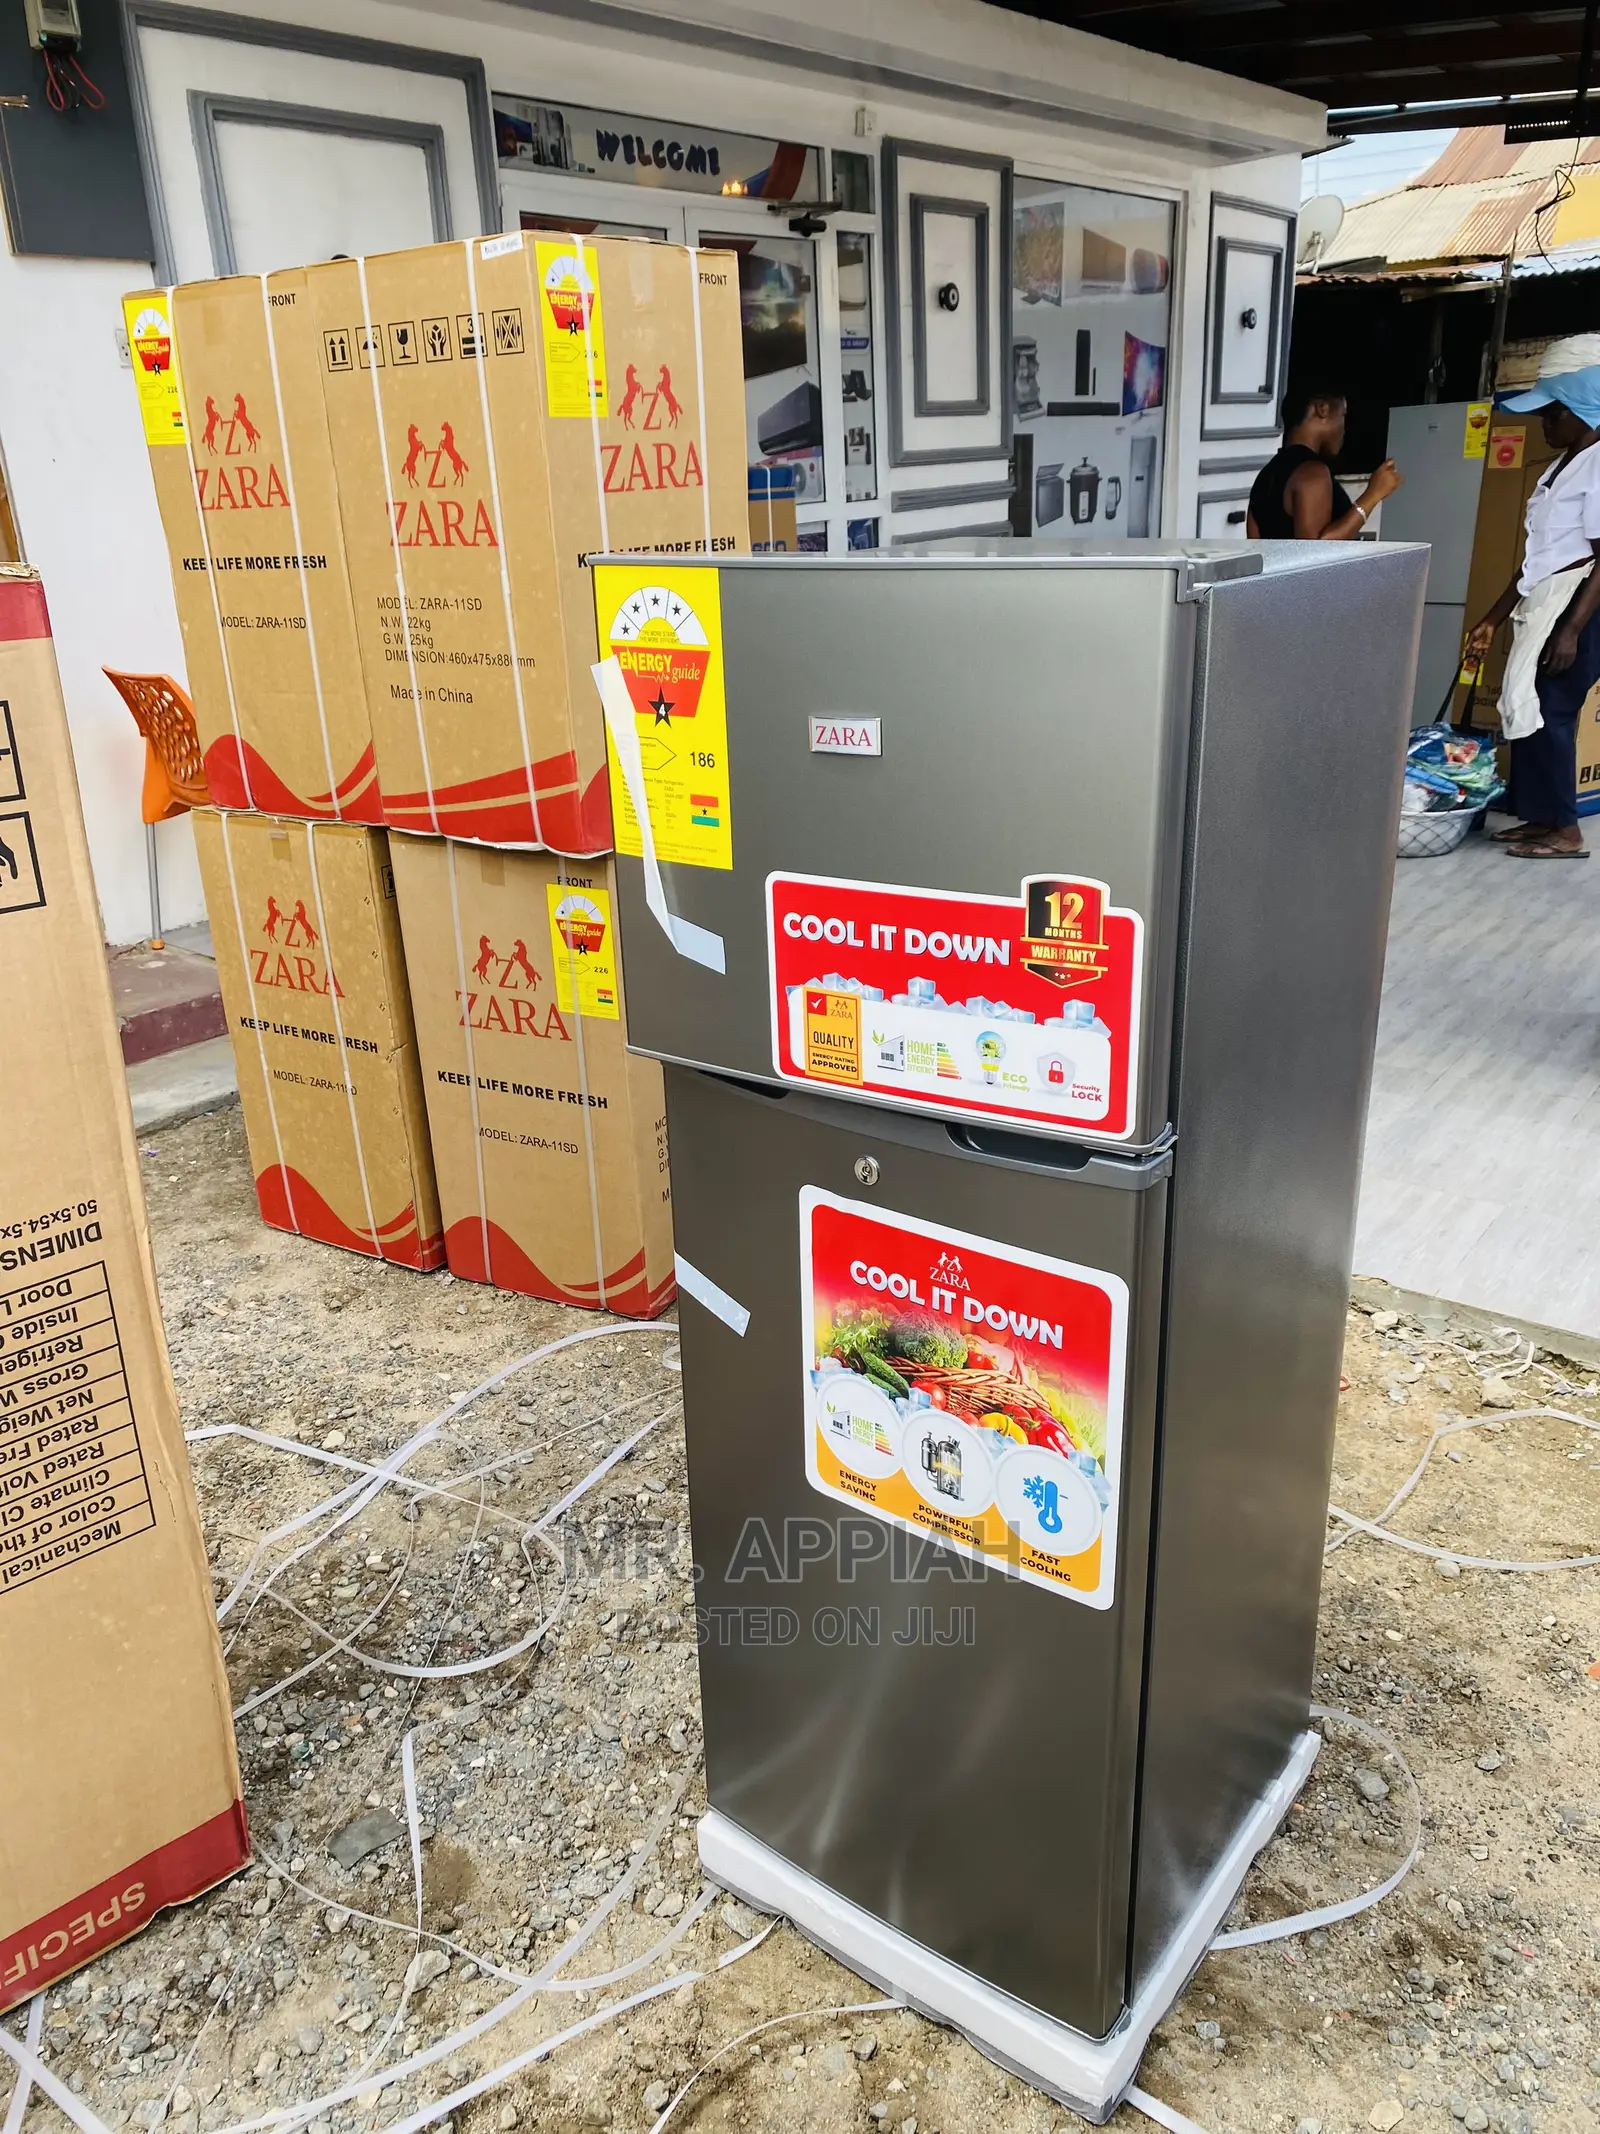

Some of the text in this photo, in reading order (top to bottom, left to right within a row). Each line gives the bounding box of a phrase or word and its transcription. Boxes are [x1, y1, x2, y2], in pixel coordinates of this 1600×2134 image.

[596, 129, 720, 175] WELCOME
[699, 272, 728, 286] FRONT
[268, 293, 296, 307] RONT
[584, 350, 599, 359] 26
[600, 440, 704, 494] ZARA
[195, 463, 291, 511] ZARA
[385, 499, 499, 547] ZARA
[183, 555, 327, 571] KEE LIFE MORE FRESH
[420, 598, 482, 611] ZARA-11SD
[256, 617, 307, 629] ZARA-11SD
[619, 647, 701, 684] ENERGY guide
[425, 687, 435, 702] in
[438, 688, 474, 704] China
[658, 703, 666, 717] 4
[815, 725, 872, 747] ZARA
[689, 751, 716, 769] 186
[1044, 891, 1085, 930] 12
[783, 911, 1011, 967] COOL IT DOWN
[1044, 926, 1083, 940] MONTHS
[1031, 944, 1097, 965] WARRANTY
[250, 949, 346, 999] ZARA
[455, 990, 572, 1042] ZARA
[830, 1009, 853, 1020] ZARA
[240, 1016, 378, 1053] KEEP LIFE MORE RESH
[813, 1031, 854, 1049] QUALITY
[812, 1052, 855, 1064] ENERGY RATING
[906, 1040, 936, 1056] HOME
[906, 1053, 935, 1067] ENERGY
[273, 1069, 308, 1085] MODEL:
[812, 1059, 857, 1073] APPROVED
[1002, 1072, 1028, 1084] ECO
[477, 1077, 509, 1093] LIFE
[512, 1083, 554, 1100] MORE
[558, 1090, 608, 1109] FRESH
[1071, 1090, 1103, 1102] LOCK
[1072, 1083, 1101, 1093] Security
[520, 1134, 579, 1154] ZARA-11SD
[0, 1199, 97, 1239] 50.5x54.5x
[0, 1221, 103, 1271] DIMENS
[929, 1266, 971, 1291] ZARA
[18, 1278, 73, 1308] Door
[850, 1259, 1063, 1350] COOL IT DOWN
[11, 1306, 79, 1340] Inside
[22, 1363, 89, 1395] Gross
[56, 1388, 94, 1415] Net
[37, 1415, 99, 1452] Rated
[852, 1415, 874, 1430] HOME
[42, 1441, 105, 1480] Rated
[30, 1469, 110, 1509] Climate
[839, 1469, 877, 1491] ENERGY
[840, 1480, 876, 1502] SAVING
[0, 1496, 116, 1554] Color of th
[912, 1512, 981, 1546] COMPRESSOR
[918, 1503, 975, 1533] POWERFUL
[2, 1520, 122, 1585] Mechanical
[1031, 1549, 1061, 1566] FAST
[1020, 1556, 1072, 1582] COOLING
[0, 1881, 146, 1986] SPECIF
